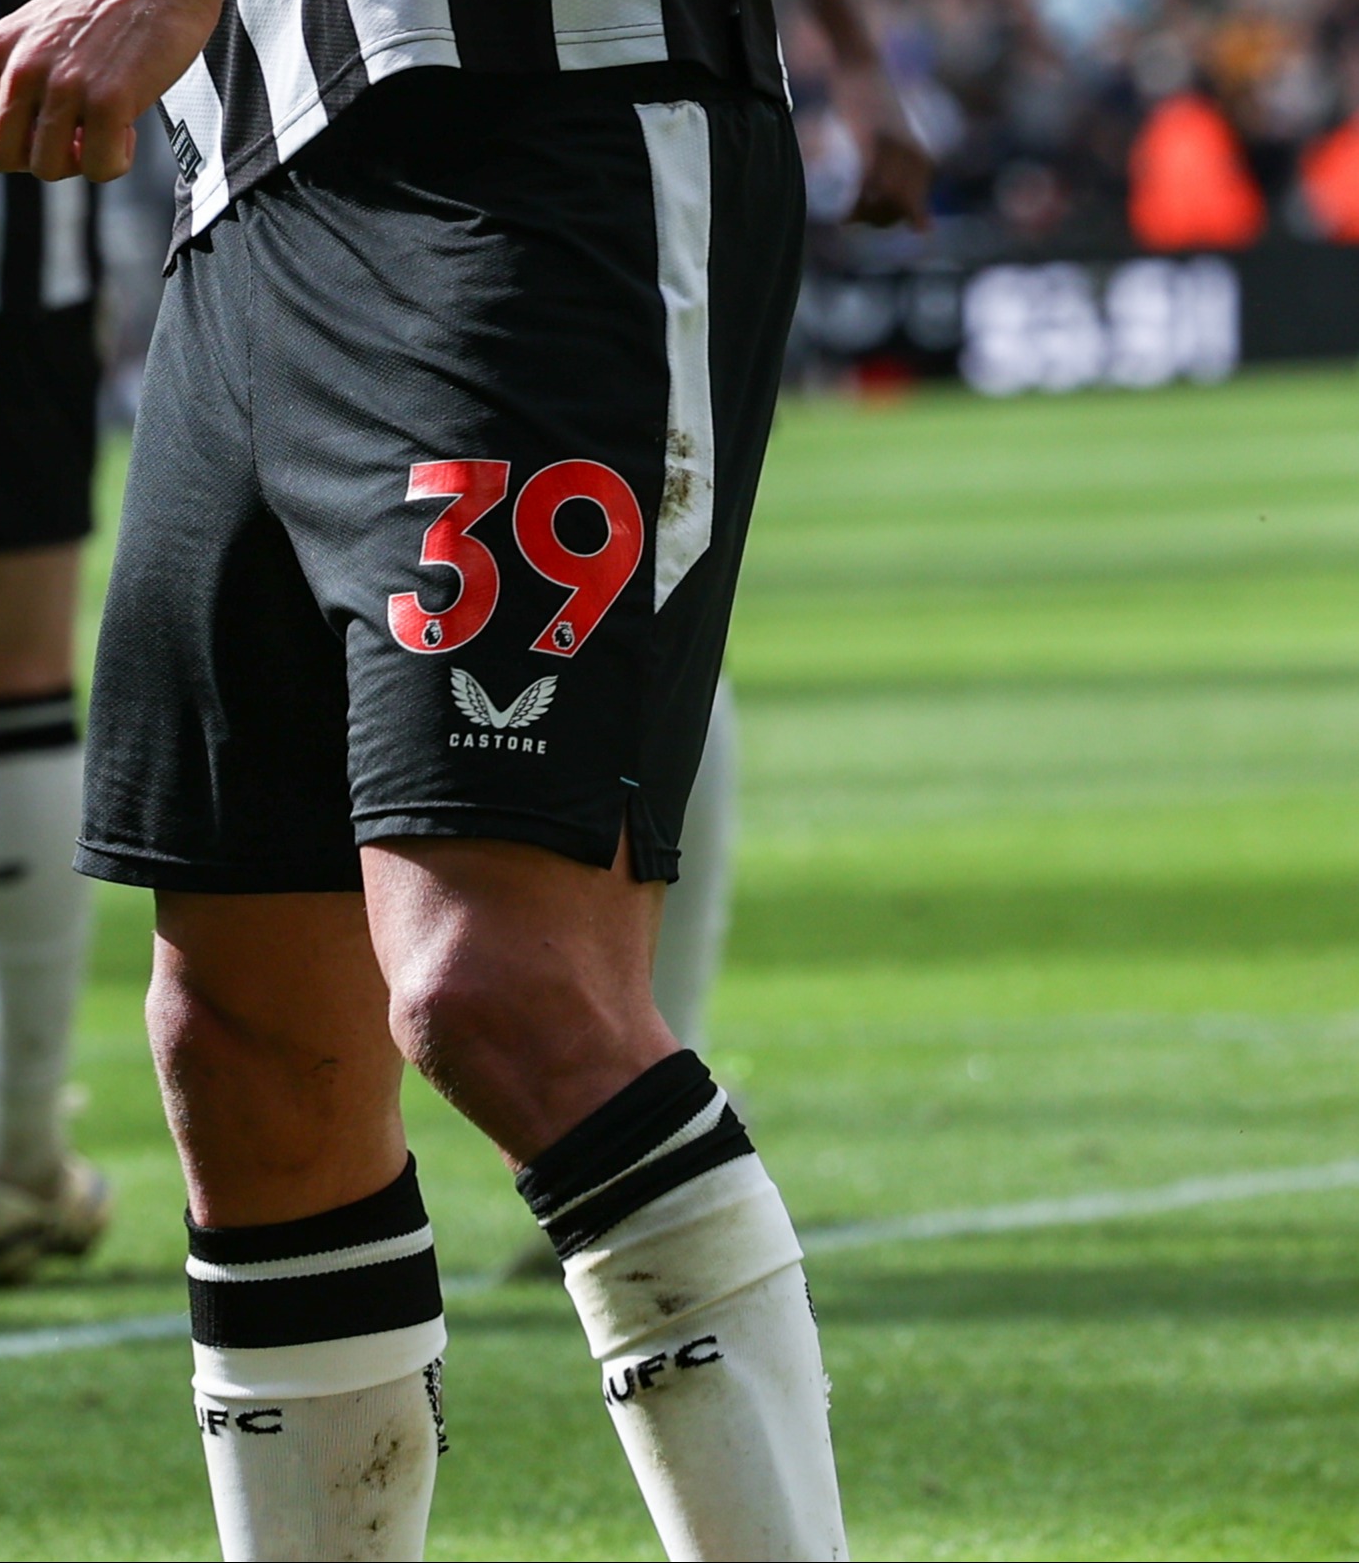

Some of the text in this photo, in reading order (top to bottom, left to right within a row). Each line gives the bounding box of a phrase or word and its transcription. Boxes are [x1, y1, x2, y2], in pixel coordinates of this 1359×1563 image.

[388, 459, 644, 657] 39
[449, 733, 547, 754] CASTORE
[606, 1335, 724, 1405] UFC
[199, 1407, 284, 1436] FC
